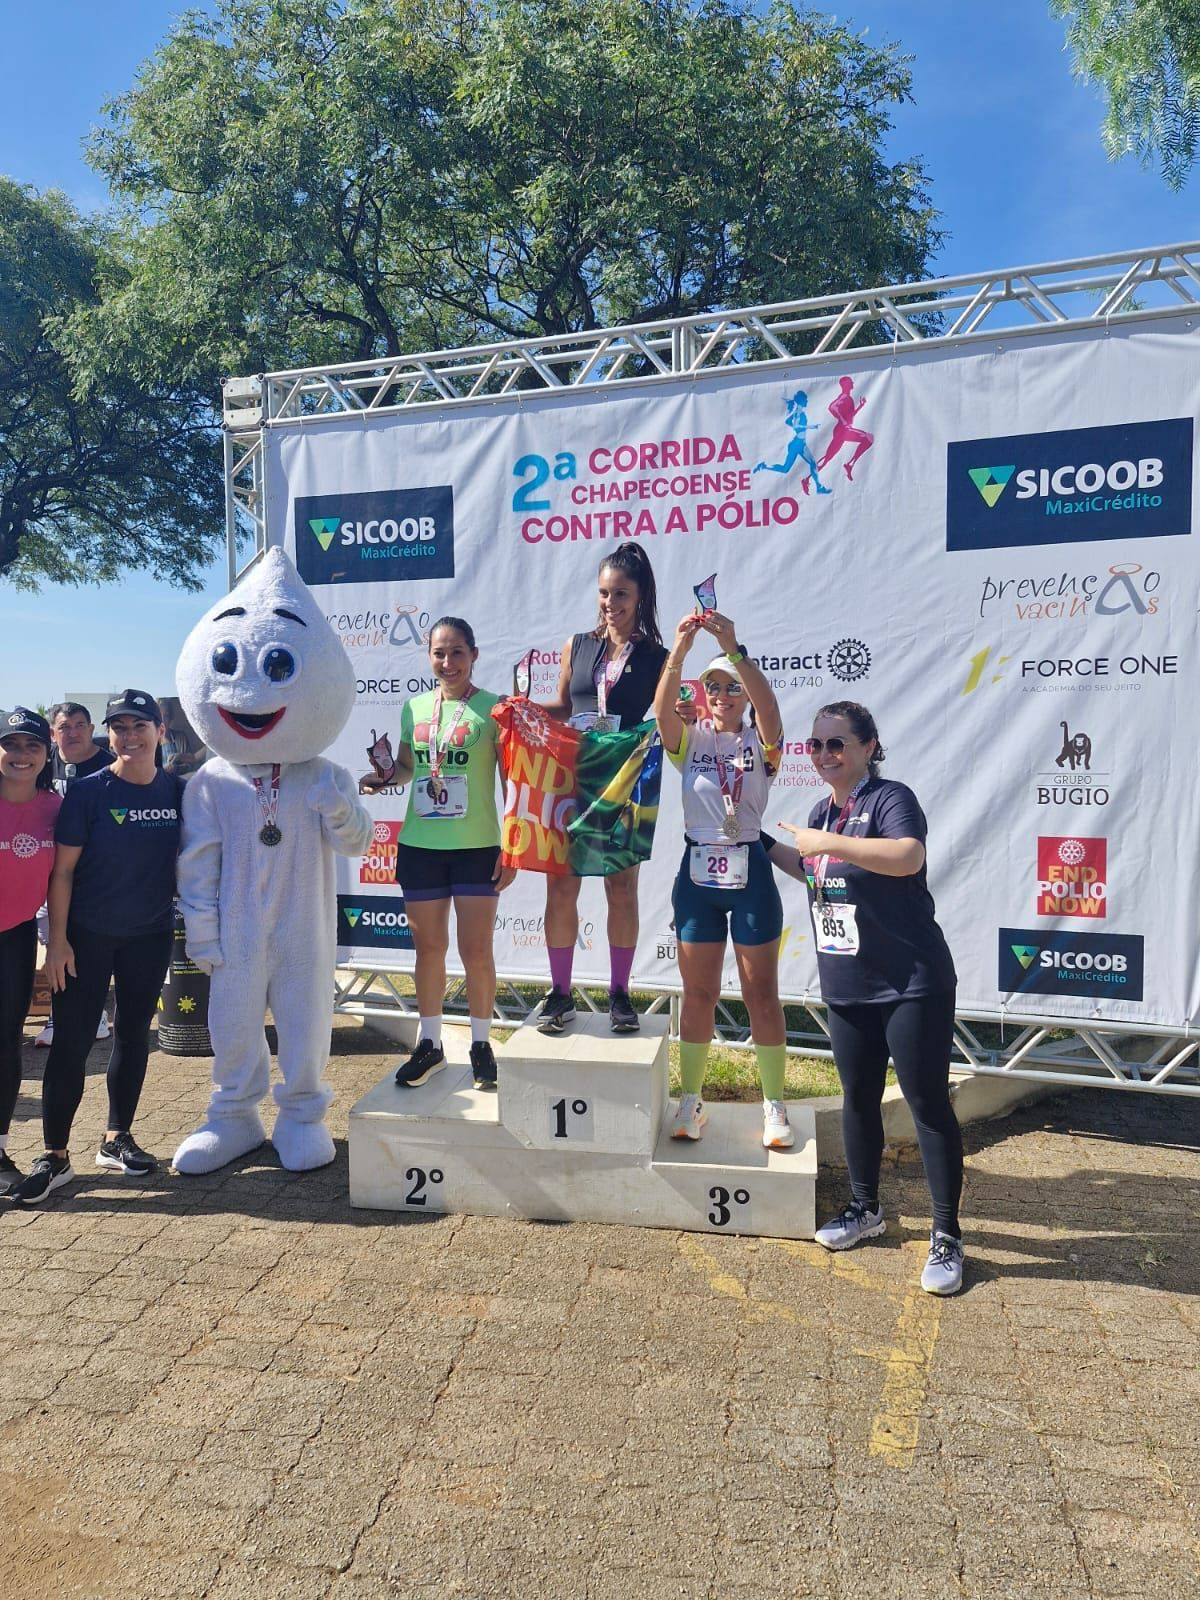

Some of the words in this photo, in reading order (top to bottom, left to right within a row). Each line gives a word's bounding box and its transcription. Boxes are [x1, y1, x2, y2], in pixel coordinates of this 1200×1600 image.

[589, 434, 742, 474] CORRIDA
[571, 469, 751, 505] CHAPECOENSE
[1015, 458, 1164, 499] SICOOB
[1045, 493, 1162, 516] MaxiCrédito
[521, 509, 657, 543] CONTRA
[664, 506, 689, 534] A
[697, 492, 799, 531] PÓLIO
[341, 516, 436, 546] SICOOB
[361, 544, 436, 560] MaxiCrédito
[750, 653, 822, 671] otaract
[1021, 658, 1109, 678] FORCE
[1119, 654, 1178, 675] ONE
[356, 680, 400, 694] ORCE
[790, 676, 823, 688] 4740
[511, 746, 574, 795] ND
[1053, 775, 1092, 785] GRUPO
[1037, 787, 1109, 806] BUGIO
[129, 809, 178, 822] SICOOB
[502, 817, 571, 865] OW
[360, 855, 397, 870] POLI
[707, 856, 728, 874] 28
[1048, 866, 1098, 883] END
[1037, 881, 1108, 899] POLIO
[1044, 898, 1101, 915] NOW
[361, 911, 409, 927] SICOO
[822, 917, 846, 935] 893
[1039, 949, 1128, 973] SICOOB
[1057, 970, 1127, 984] MaxiCrédito
[552, 1098, 588, 1138] 1º
[405, 1167, 444, 1206] 2º
[708, 1186, 751, 1227] 3º
